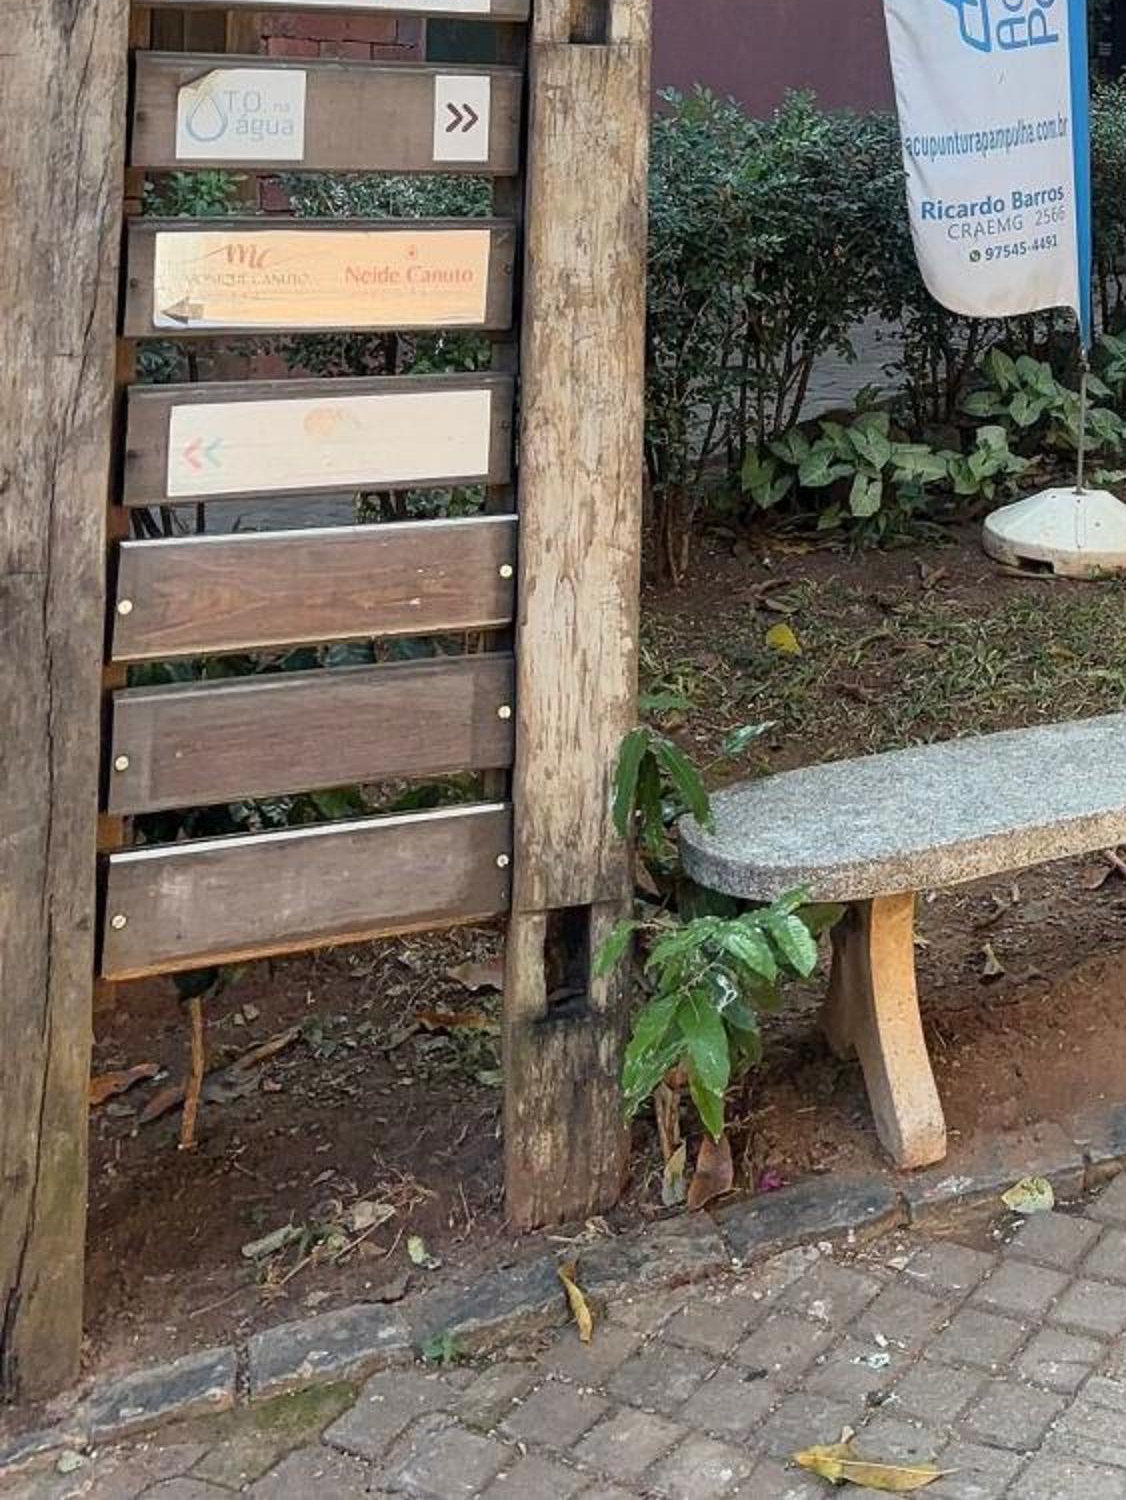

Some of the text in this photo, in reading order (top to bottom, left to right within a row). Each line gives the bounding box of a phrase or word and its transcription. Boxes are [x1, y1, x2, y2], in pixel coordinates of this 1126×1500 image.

[234, 113, 294, 141] água
[904, 111, 1068, 162] acupunturapampulha.com.br
[920, 186, 1065, 221] Ricardo Barros
[947, 214, 1024, 240] CRAEMG
[344, 264, 474, 284] Neide Canuto
